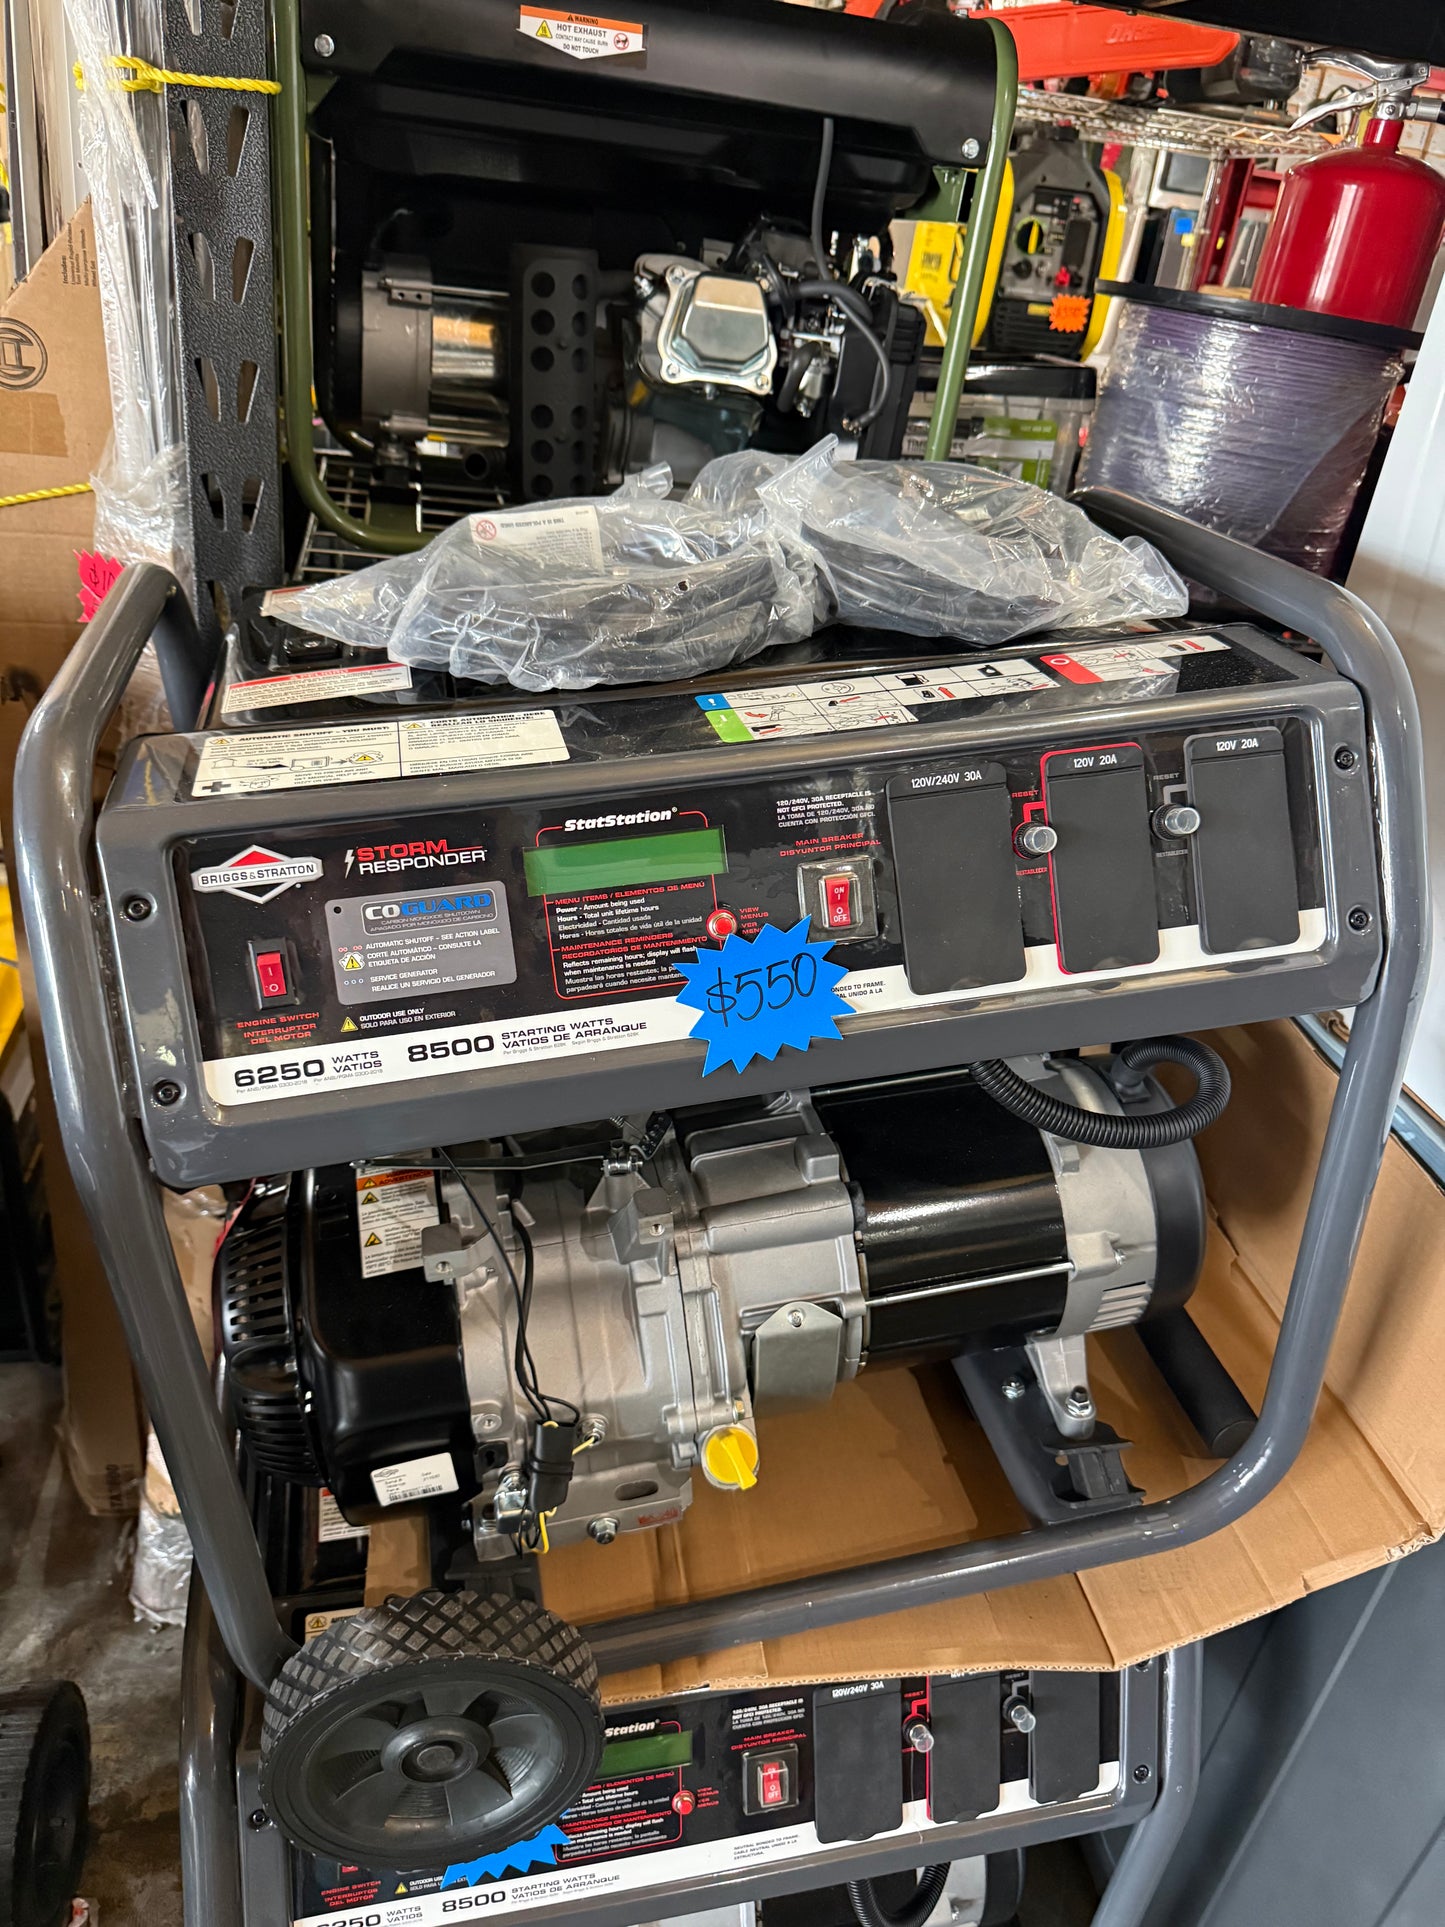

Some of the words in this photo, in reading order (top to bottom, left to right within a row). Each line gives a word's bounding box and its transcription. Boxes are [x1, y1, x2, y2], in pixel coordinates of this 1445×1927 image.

[574, 16, 598, 25] WARNING
[556, 34, 574, 42] CONTACT
[557, 24, 571, 32] HOT
[574, 26, 607, 38] EXHAUST
[583, 46, 599, 54] TOUCH
[1216, 740, 1237, 752] 120V
[1241, 738, 1259, 749] 20A
[1074, 757, 1094, 768] 120V
[1100, 754, 1117, 766] 20A
[911, 773, 960, 789] 120V/240V
[964, 771, 982, 782] 30A
[825, 792, 863, 801] RECEPTACLE
[778, 820, 804, 828] CUENTA
[795, 838, 819, 846] MAIN
[822, 832, 864, 842] BREAKER
[357, 840, 448, 861] STORM
[780, 846, 832, 856] DISYUNTOR
[834, 840, 881, 850] PRINCIPAL
[359, 850, 486, 875] RESPONDER
[555, 897, 580, 905] MENU
[582, 894, 609, 902] ITEMS
[615, 887, 665, 898] ELEMENTOS
[556, 906, 578, 914] Power
[583, 902, 609, 911] Amount
[610, 899, 628, 908] being
[629, 897, 645, 905] used
[739, 906, 759, 914] VIEW
[410, 914, 442, 923] MONOXIDE
[444, 909, 481, 918] SHUTDOWN
[557, 915, 578, 923] Hours
[615, 907, 639, 915] lifetime
[640, 905, 659, 913] hours
[740, 911, 769, 920] MENUS
[558, 921, 597, 931] Electricidad
[602, 916, 631, 926] Cantidad
[366, 940, 404, 949] AUTOMATIC
[404, 936, 434, 945] SHUTOFF
[441, 933, 454, 941] SEE
[455, 930, 479, 939] ACTION
[480, 928, 500, 936] LABEL
[561, 939, 623, 952] MAINTENANCE
[625, 933, 674, 944] REMINDERS
[367, 951, 389, 959] CORTE
[390, 945, 432, 956] AUTOMÁTICO
[439, 941, 472, 951] CONSULTE
[562, 947, 629, 960] RECORDATORIOS
[644, 936, 708, 950] MANTENIMIENTO
[368, 958, 399, 967] ETIQUETA
[411, 953, 436, 962] ACCIÓN
[563, 960, 590, 969] Reflects
[591, 956, 623, 965] remaining
[624, 954, 646, 962] hours;
[647, 949, 669, 959] display
[370, 973, 398, 982] SERVICE
[399, 968, 438, 979] GENERATOR
[564, 968, 582, 976] when
[583, 963, 625, 974] maintenance
[633, 959, 656, 968] needed
[372, 982, 398, 992] REALICE
[412, 978, 441, 987] SERVICIO
[456, 971, 495, 981] GENERADOR
[565, 975, 594, 985] Muestra
[606, 971, 625, 979] horas
[605, 979, 628, 988] cuando
[629, 976, 657, 984] necesite
[706, 952, 817, 1027] $550
[236, 1017, 277, 1029] ENGINE
[279, 1012, 320, 1023] SWITCH
[360, 1012, 392, 1022] OUTDOOR
[392, 1010, 406, 1018] USE
[407, 1008, 425, 1016] ONLY
[425, 1010, 456, 1021] EXTERIOR
[243, 1023, 317, 1038] INTERRUPTOR
[502, 1024, 566, 1040] STARTING
[570, 1018, 614, 1030] WATTS
[502, 1037, 549, 1049] VATIOS
[553, 1033, 571, 1042] DE
[575, 1022, 647, 1039] ARRANQUE
[251, 1036, 272, 1045] DEL
[274, 1031, 311, 1042] MOTOR
[407, 1035, 495, 1063] 8500
[331, 1051, 379, 1064] WATTS
[234, 1059, 325, 1087] 6250
[333, 1060, 383, 1074] VATIOS
[832, 1684, 868, 1698] 120V/240V
[871, 1681, 885, 1691] 30A
[604, 1718, 661, 1738] Station®
[763, 1729, 795, 1739] BREAKER
[731, 1740, 771, 1750] DISYUNTOR
[772, 1733, 806, 1743] PRINCIPAL
[321, 1885, 350, 1896] ENGINE
[352, 1880, 381, 1889] SWITCH
[511, 1880, 560, 1894] STARTING
[563, 1873, 596, 1884] WATTS
[511, 1889, 547, 1900] VATIOS
[549, 1885, 563, 1893] DE
[565, 1875, 621, 1890] ARRANQUE
[325, 1888, 379, 1903] INTERRUPTOR
[346, 1894, 374, 1904] MOTOR
[442, 1890, 506, 1913] 8500
[387, 1906, 421, 1917] WATTS
[387, 1912, 423, 1923] VATIOS
